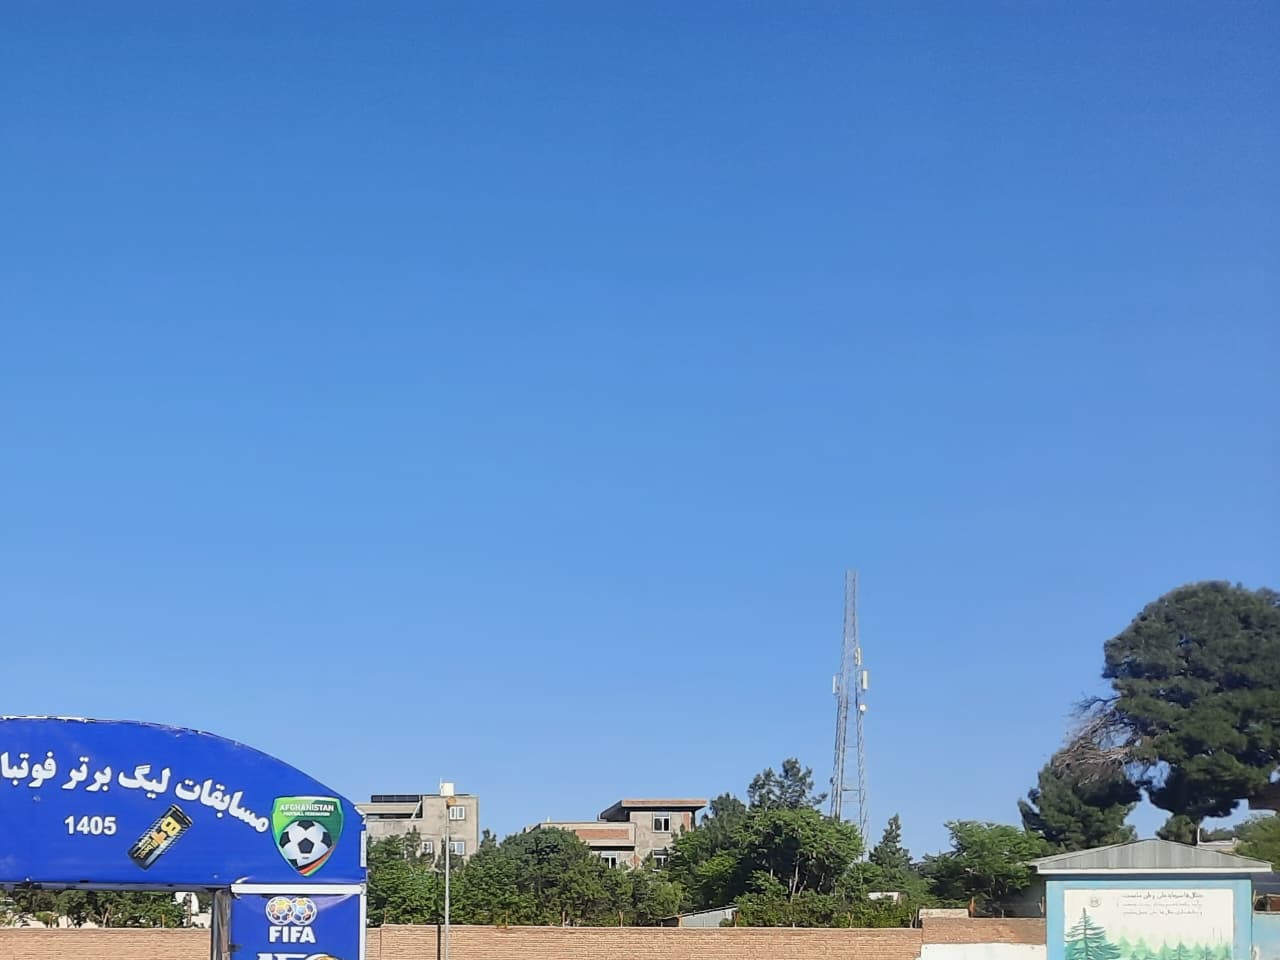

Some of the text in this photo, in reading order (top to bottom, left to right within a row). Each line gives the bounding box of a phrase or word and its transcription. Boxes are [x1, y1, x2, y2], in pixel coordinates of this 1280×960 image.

[61, 756, 112, 792] برتر
[118, 764, 171, 799] لیگ
[175, 779, 269, 833] مسابقات
[279, 803, 335, 812] AFGHANISTAN
[64, 816, 117, 836] 1405
[269, 926, 316, 943] FIFA
